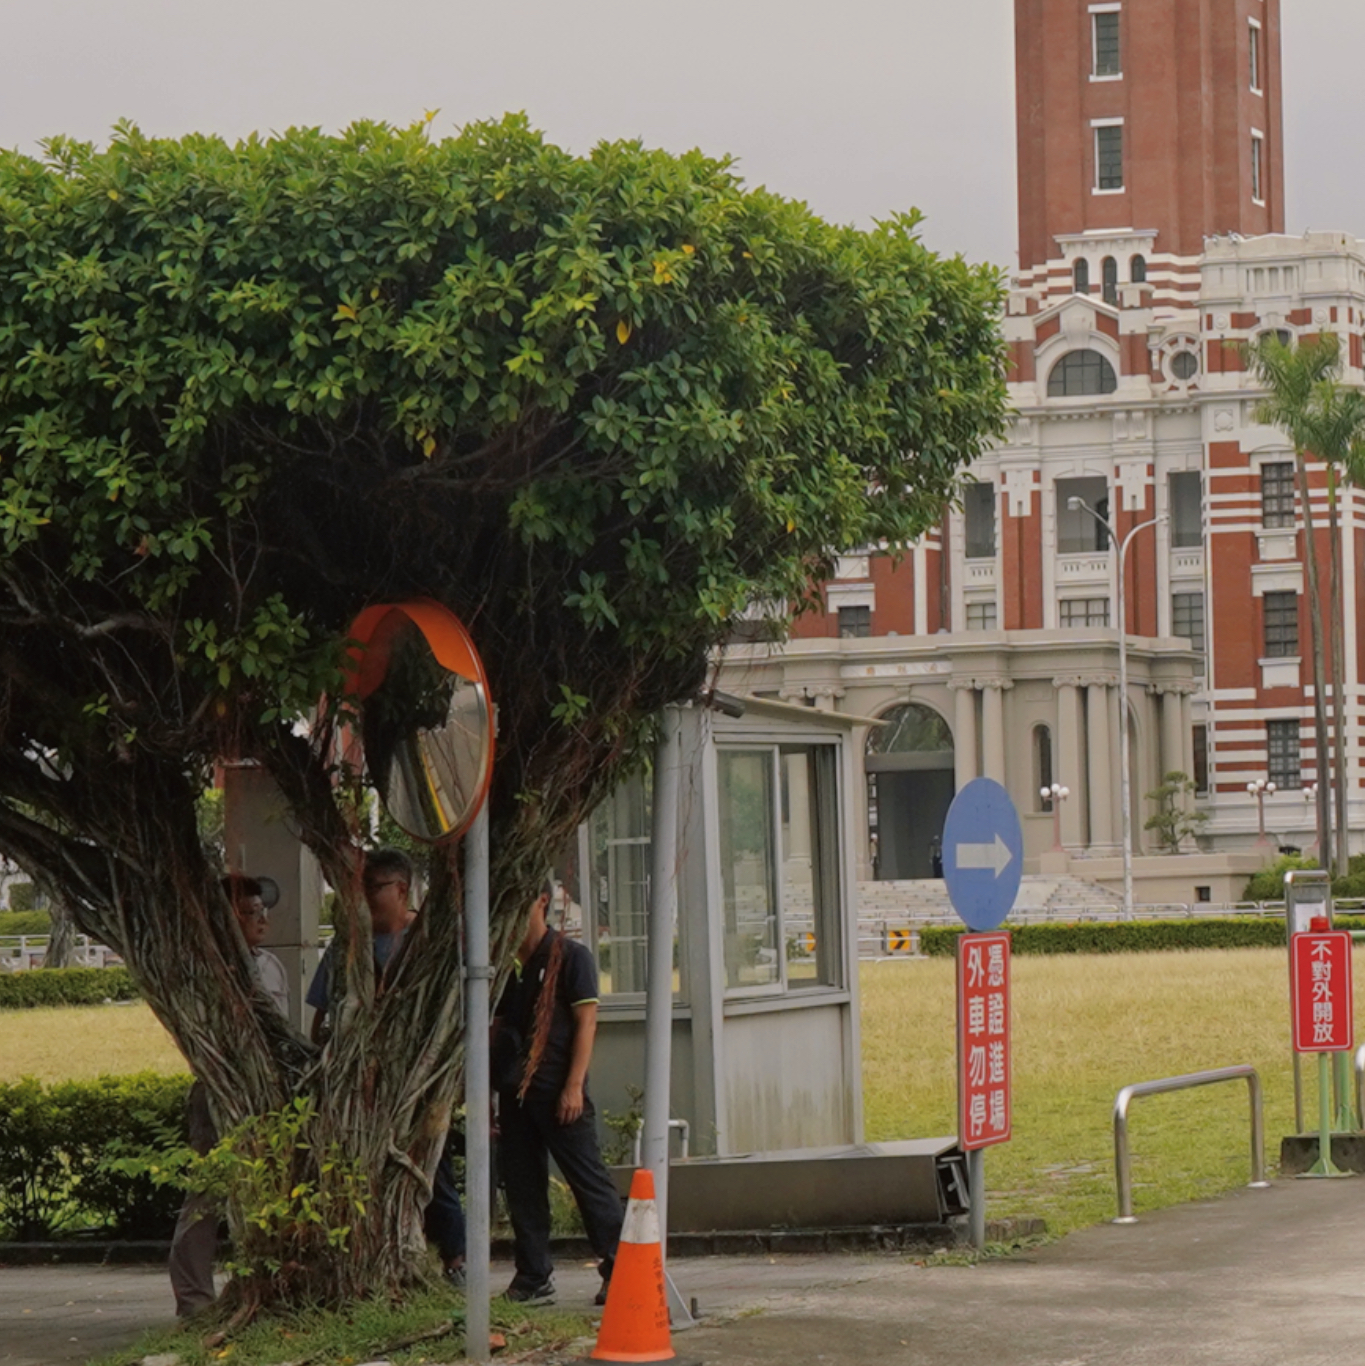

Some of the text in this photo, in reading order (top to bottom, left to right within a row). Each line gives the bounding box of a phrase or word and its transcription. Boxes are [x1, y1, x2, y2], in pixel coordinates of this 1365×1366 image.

[968, 947, 985, 1136] 外車勿停
[987, 945, 1005, 1131] 憑證進場
[1311, 940, 1334, 1043] 不對外開放
